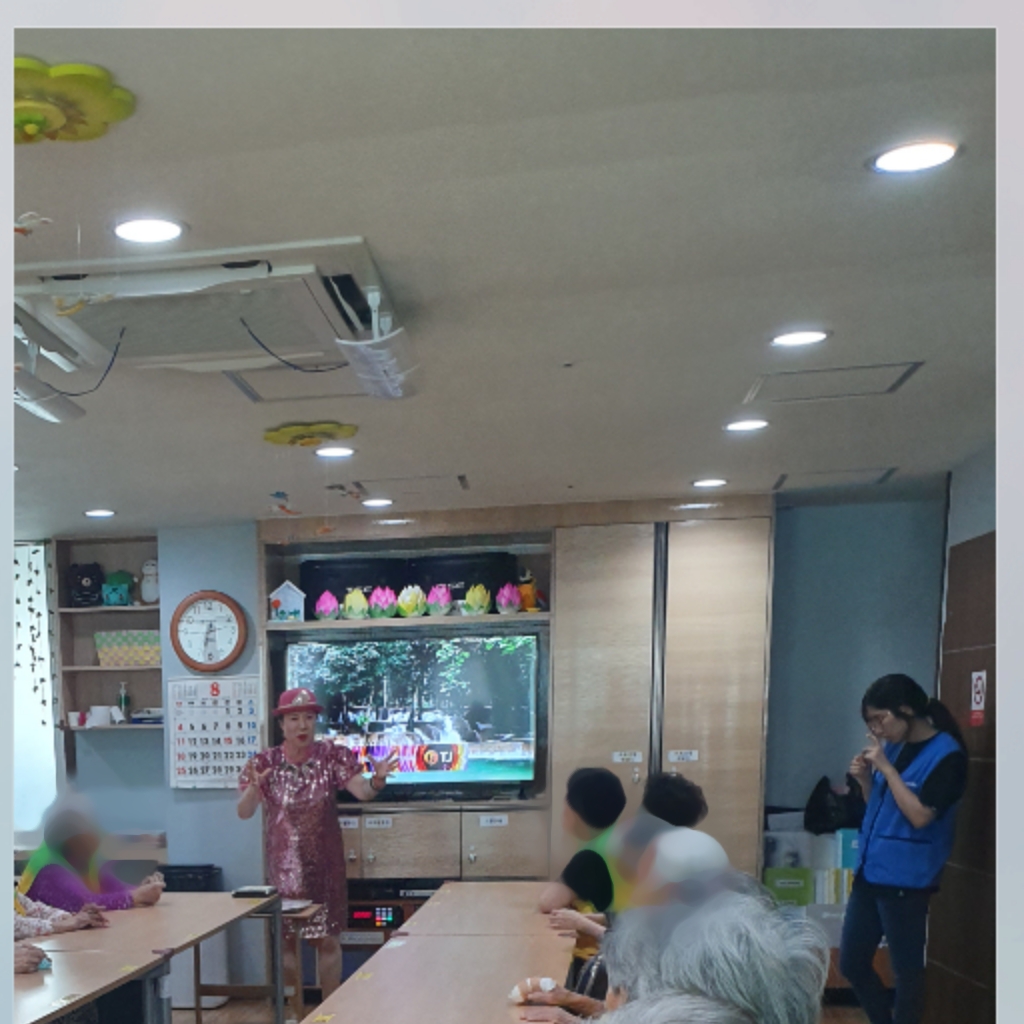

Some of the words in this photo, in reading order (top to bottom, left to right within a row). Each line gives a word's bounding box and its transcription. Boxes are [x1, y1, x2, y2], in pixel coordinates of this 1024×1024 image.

[209, 681, 221, 697] 8
[177, 737, 185, 746] 11
[200, 737, 209, 746] 13
[212, 737, 221, 746] 14
[247, 735, 256, 744] 17
[439, 751, 453, 763] TJ
[177, 766, 186, 775] 25
[188, 766, 198, 775] 26
[200, 766, 210, 775] 27
[212, 765, 222, 775] 28
[223, 765, 234, 775] 29
